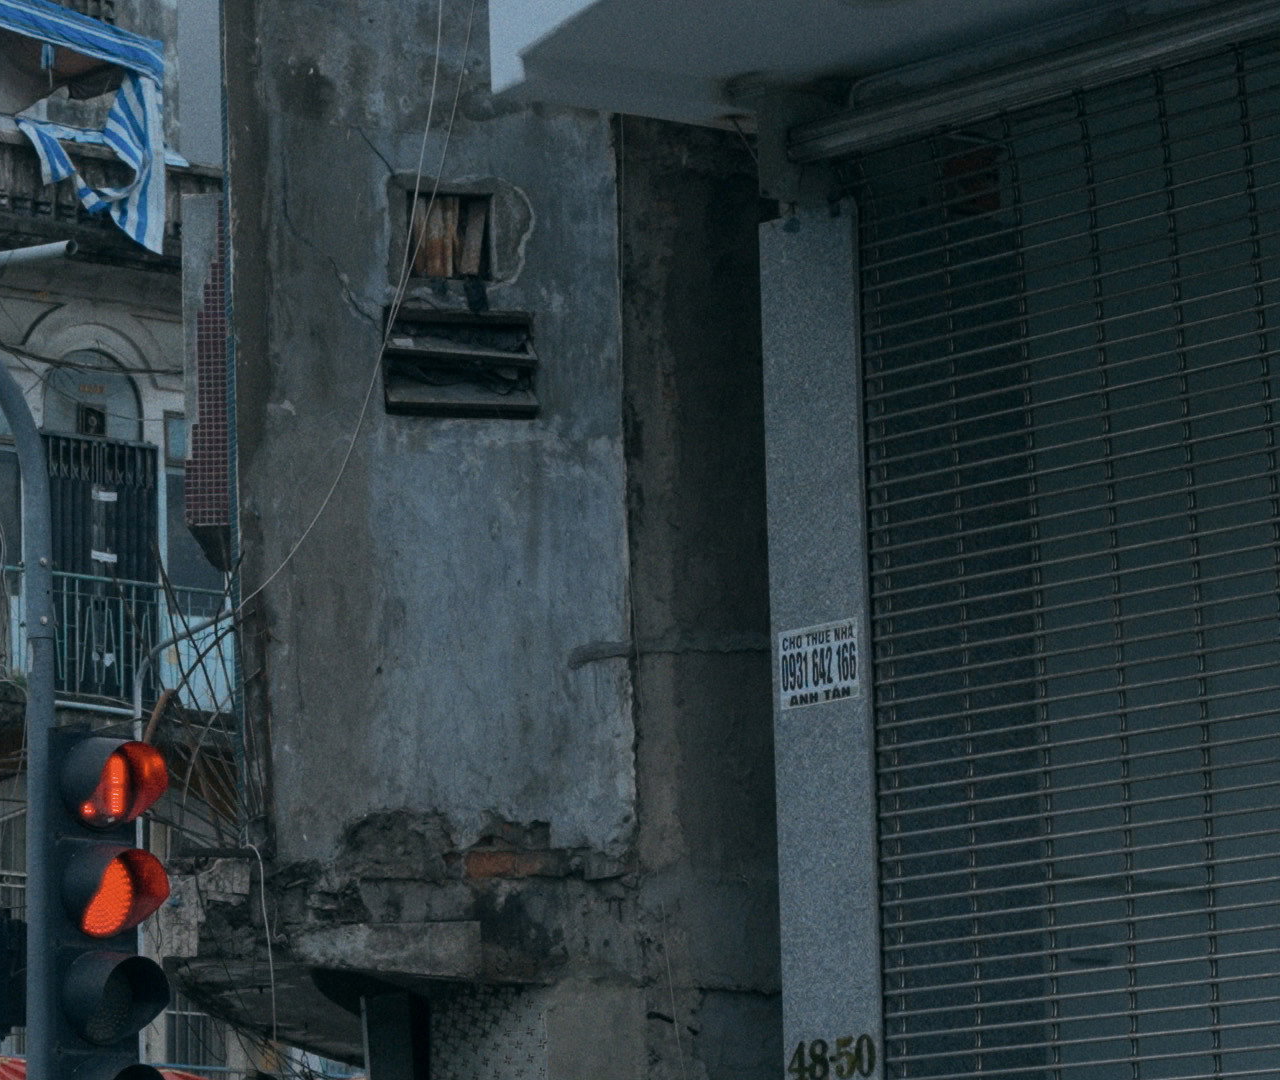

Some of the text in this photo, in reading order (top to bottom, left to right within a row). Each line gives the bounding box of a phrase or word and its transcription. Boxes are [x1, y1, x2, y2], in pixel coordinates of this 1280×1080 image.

[782, 635, 803, 651] CHO
[781, 641, 857, 692] 0931 642 166
[790, 692, 818, 707] ANH
